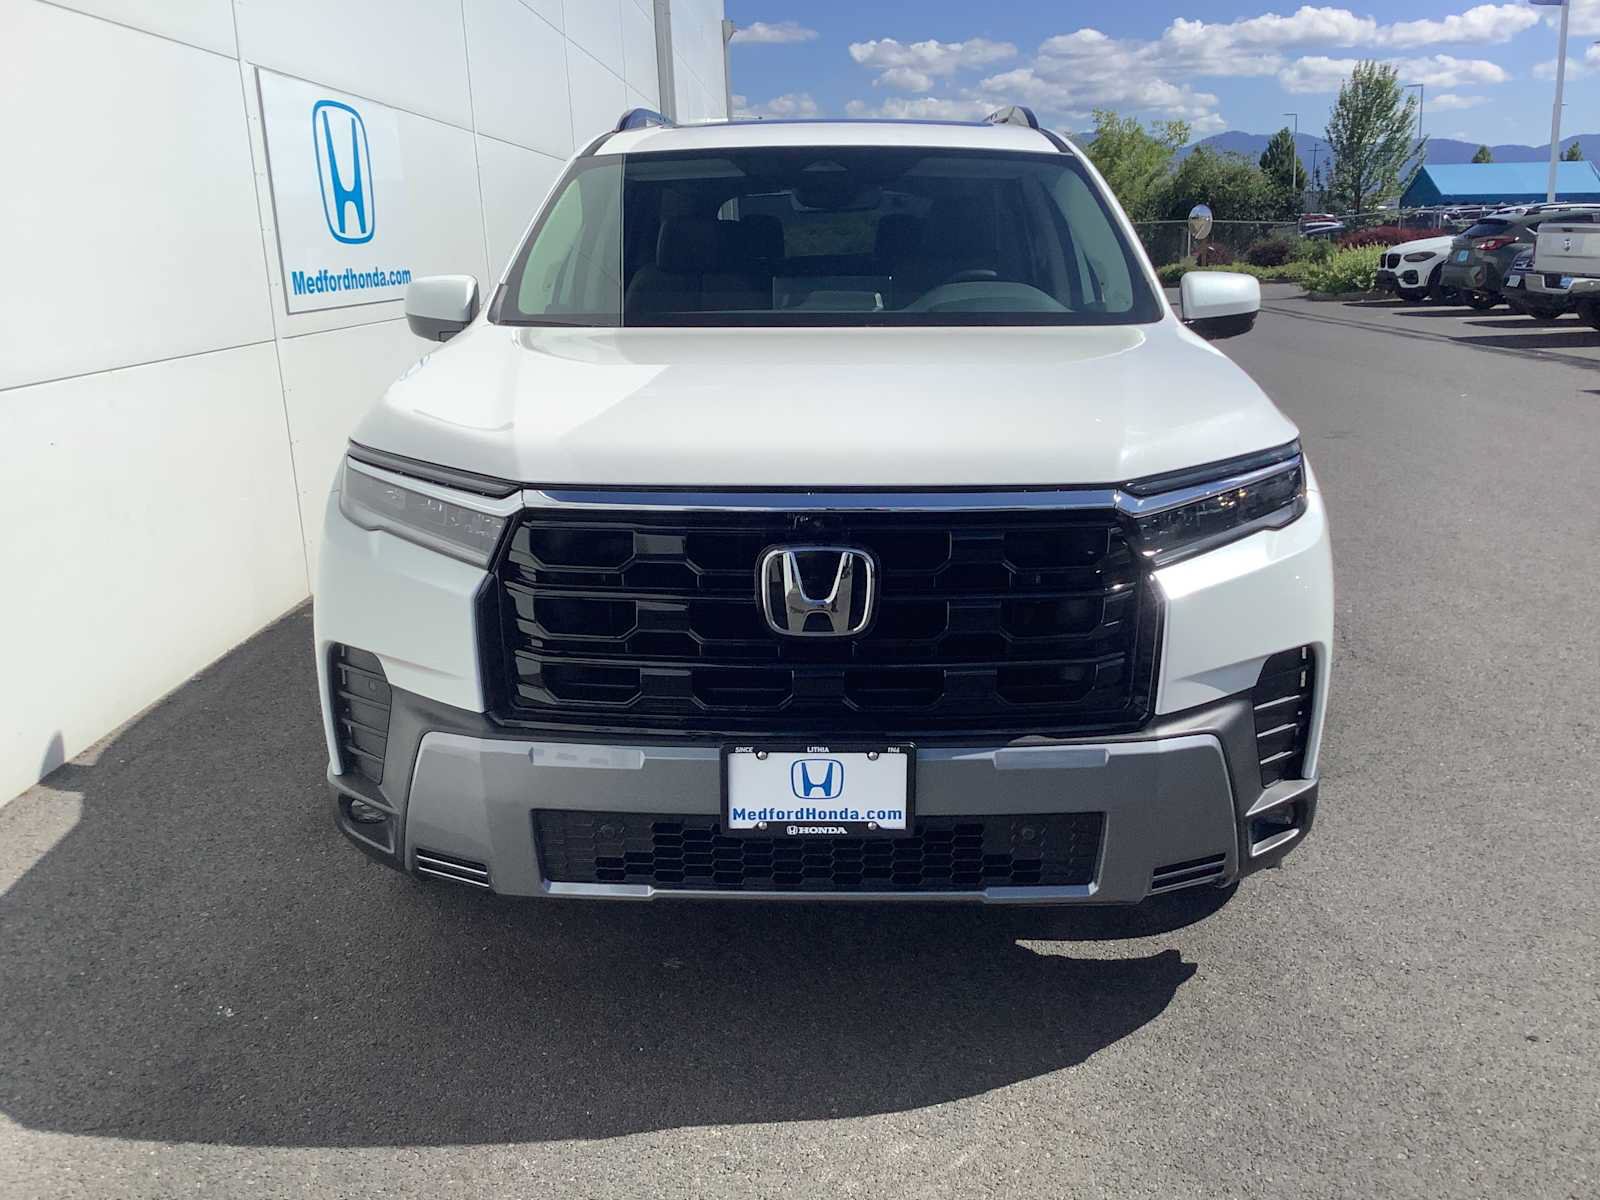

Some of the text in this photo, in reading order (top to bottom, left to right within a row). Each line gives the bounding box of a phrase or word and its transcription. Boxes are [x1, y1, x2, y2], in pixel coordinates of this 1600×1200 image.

[291, 267, 412, 295] Medfordhonda.com
[732, 807, 903, 821] MedfordHonda.com
[798, 826, 848, 834] HONDA
